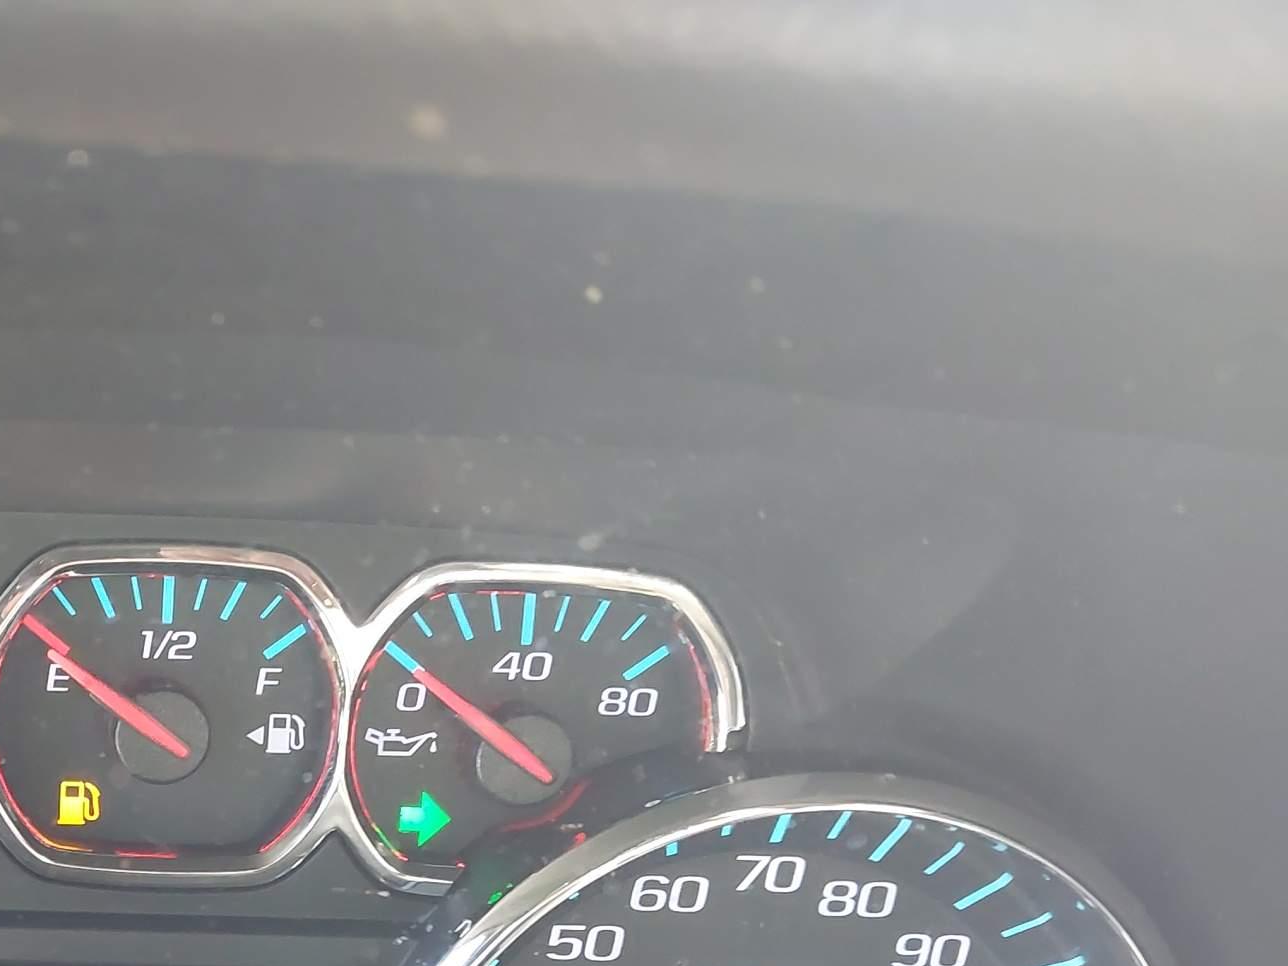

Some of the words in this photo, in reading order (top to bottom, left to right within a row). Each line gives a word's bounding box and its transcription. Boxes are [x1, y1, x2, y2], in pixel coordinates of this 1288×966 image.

[141, 630, 197, 660] 1/2
[46, 663, 70, 692] E
[255, 667, 283, 695] F
[491, 651, 553, 681] 40
[396, 682, 426, 711] 0
[597, 687, 659, 717] 80
[735, 855, 806, 892] 70
[629, 875, 709, 912] 60
[818, 880, 898, 918] 80
[546, 924, 625, 962] 50
